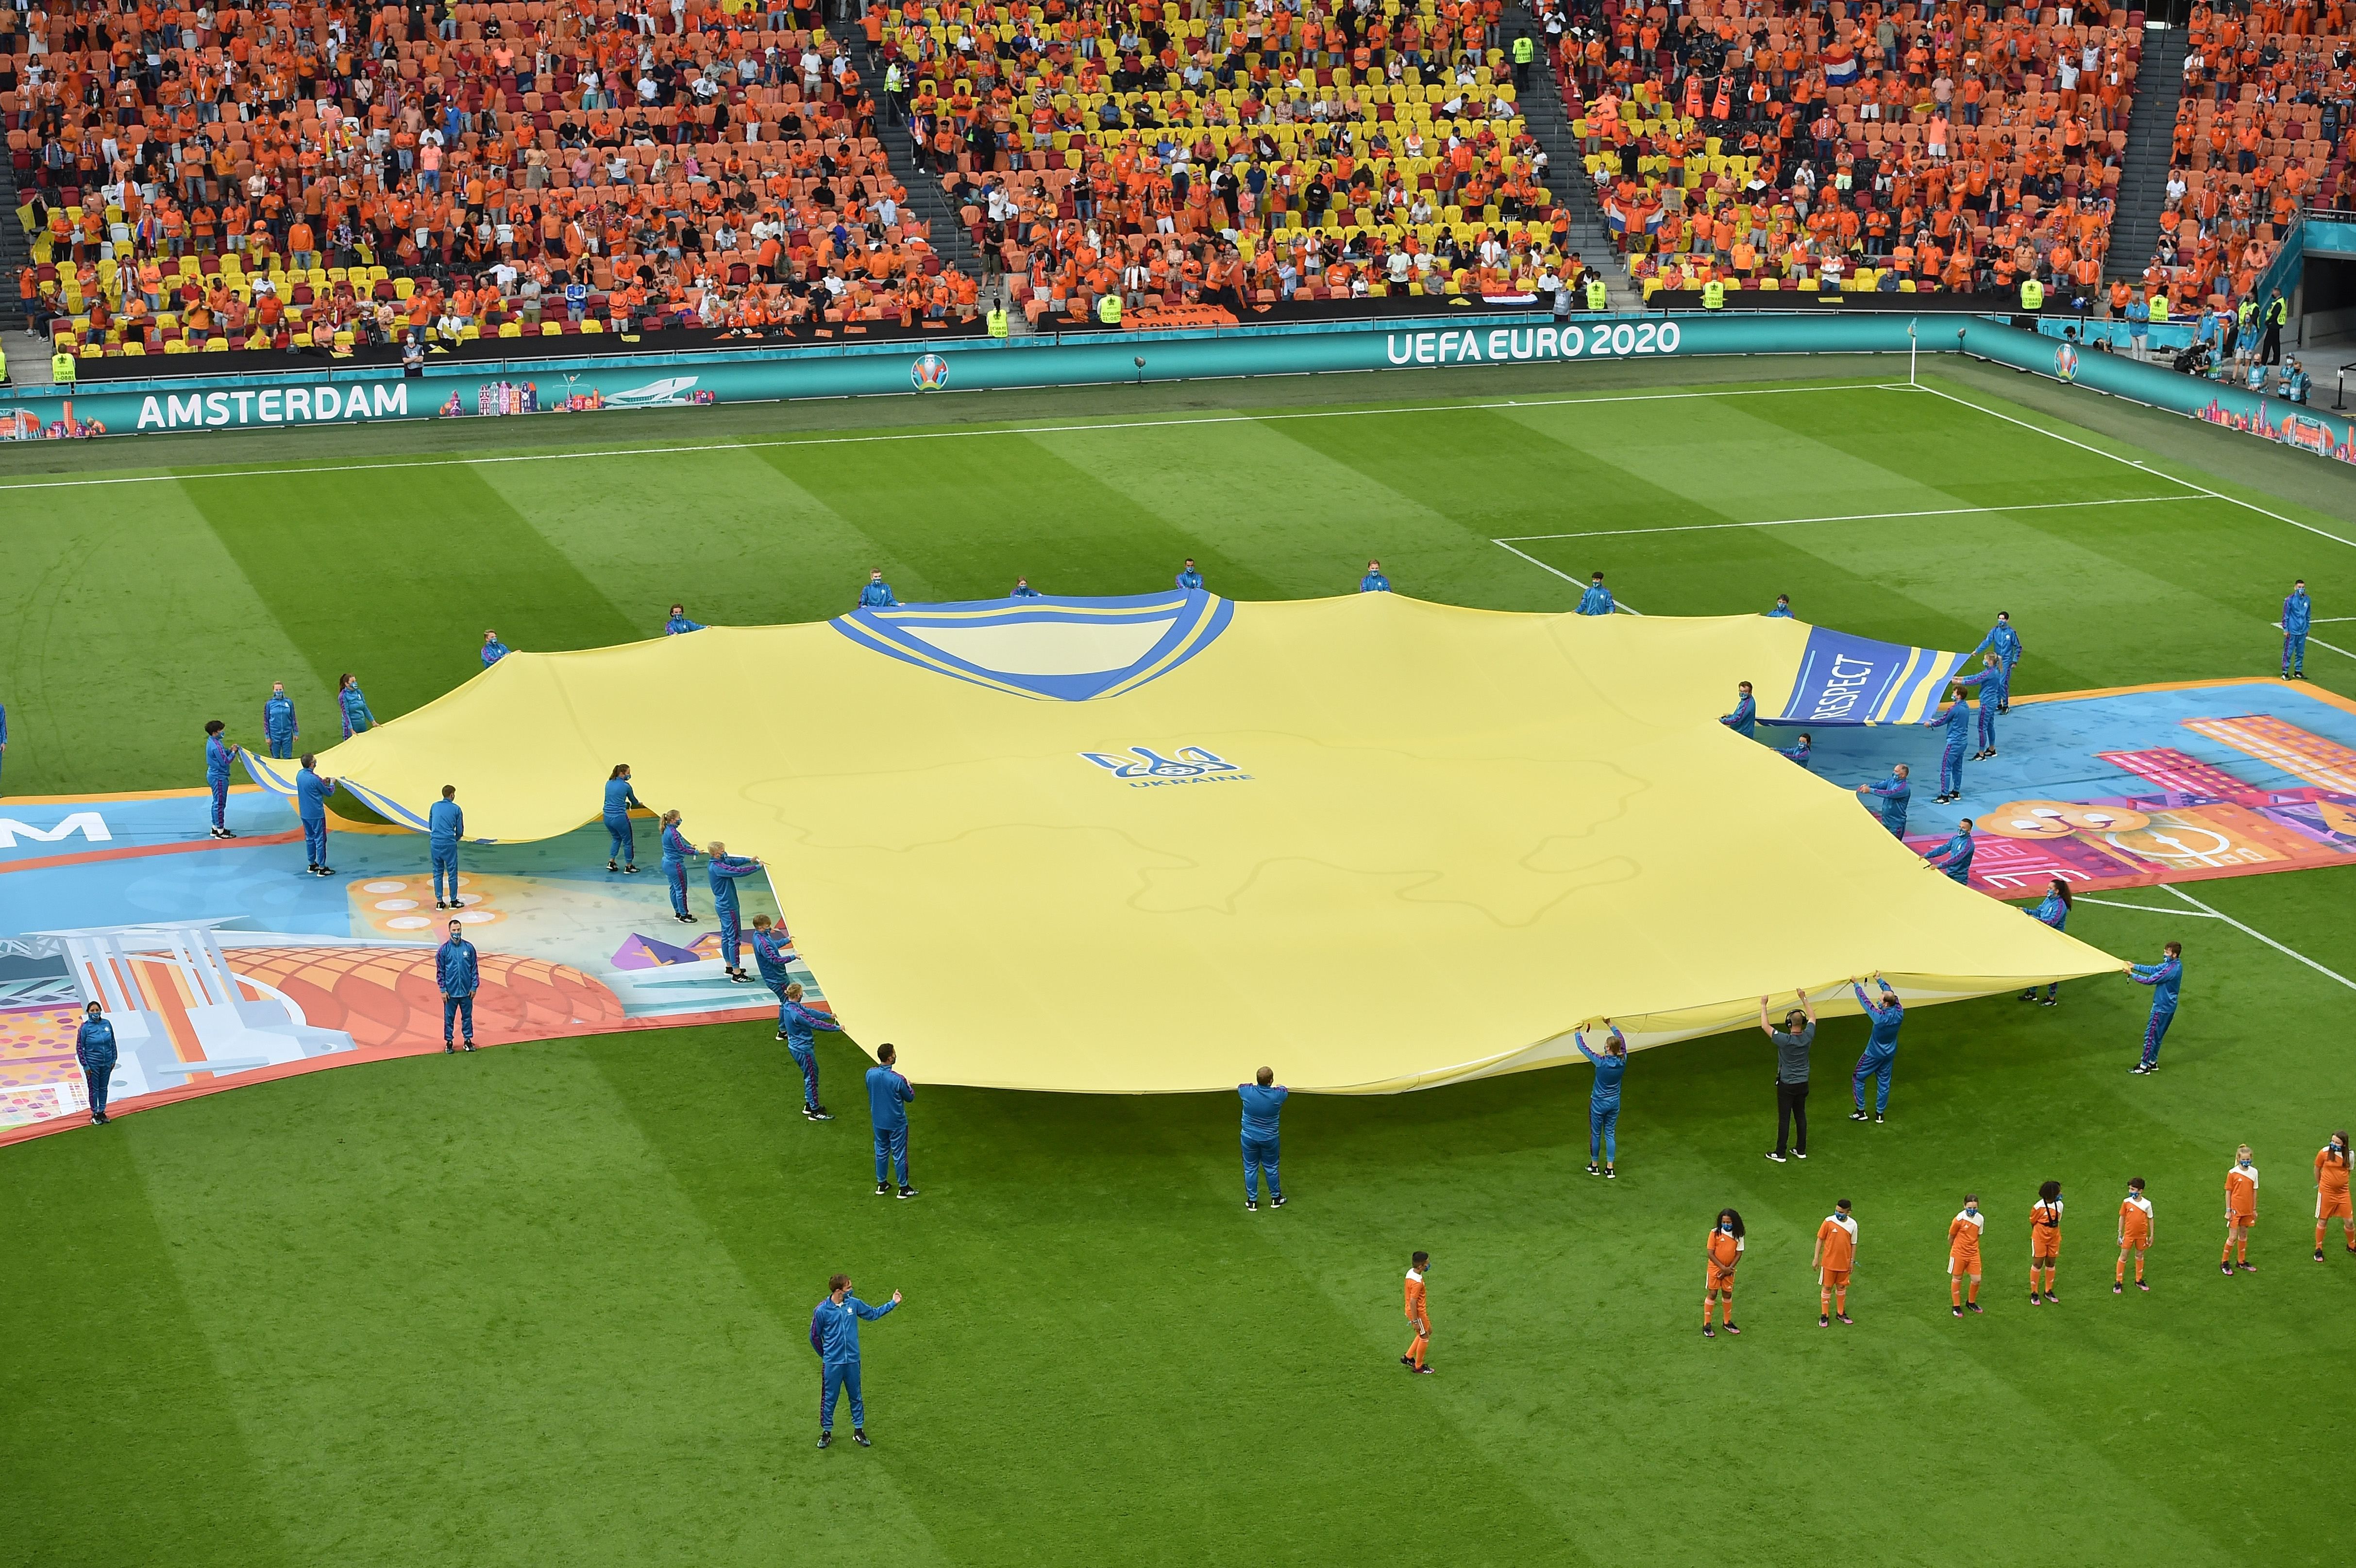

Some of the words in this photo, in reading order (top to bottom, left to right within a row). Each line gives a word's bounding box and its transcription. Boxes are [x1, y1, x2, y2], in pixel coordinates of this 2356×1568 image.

[1387, 329, 1482, 365] UEFA
[1488, 325, 1584, 360] EURO
[1590, 321, 1681, 355] 2020
[136, 383, 408, 429] AMSTERDAM
[1809, 653, 1874, 721] RESPECT
[1129, 774, 1255, 788] UKRAINE
